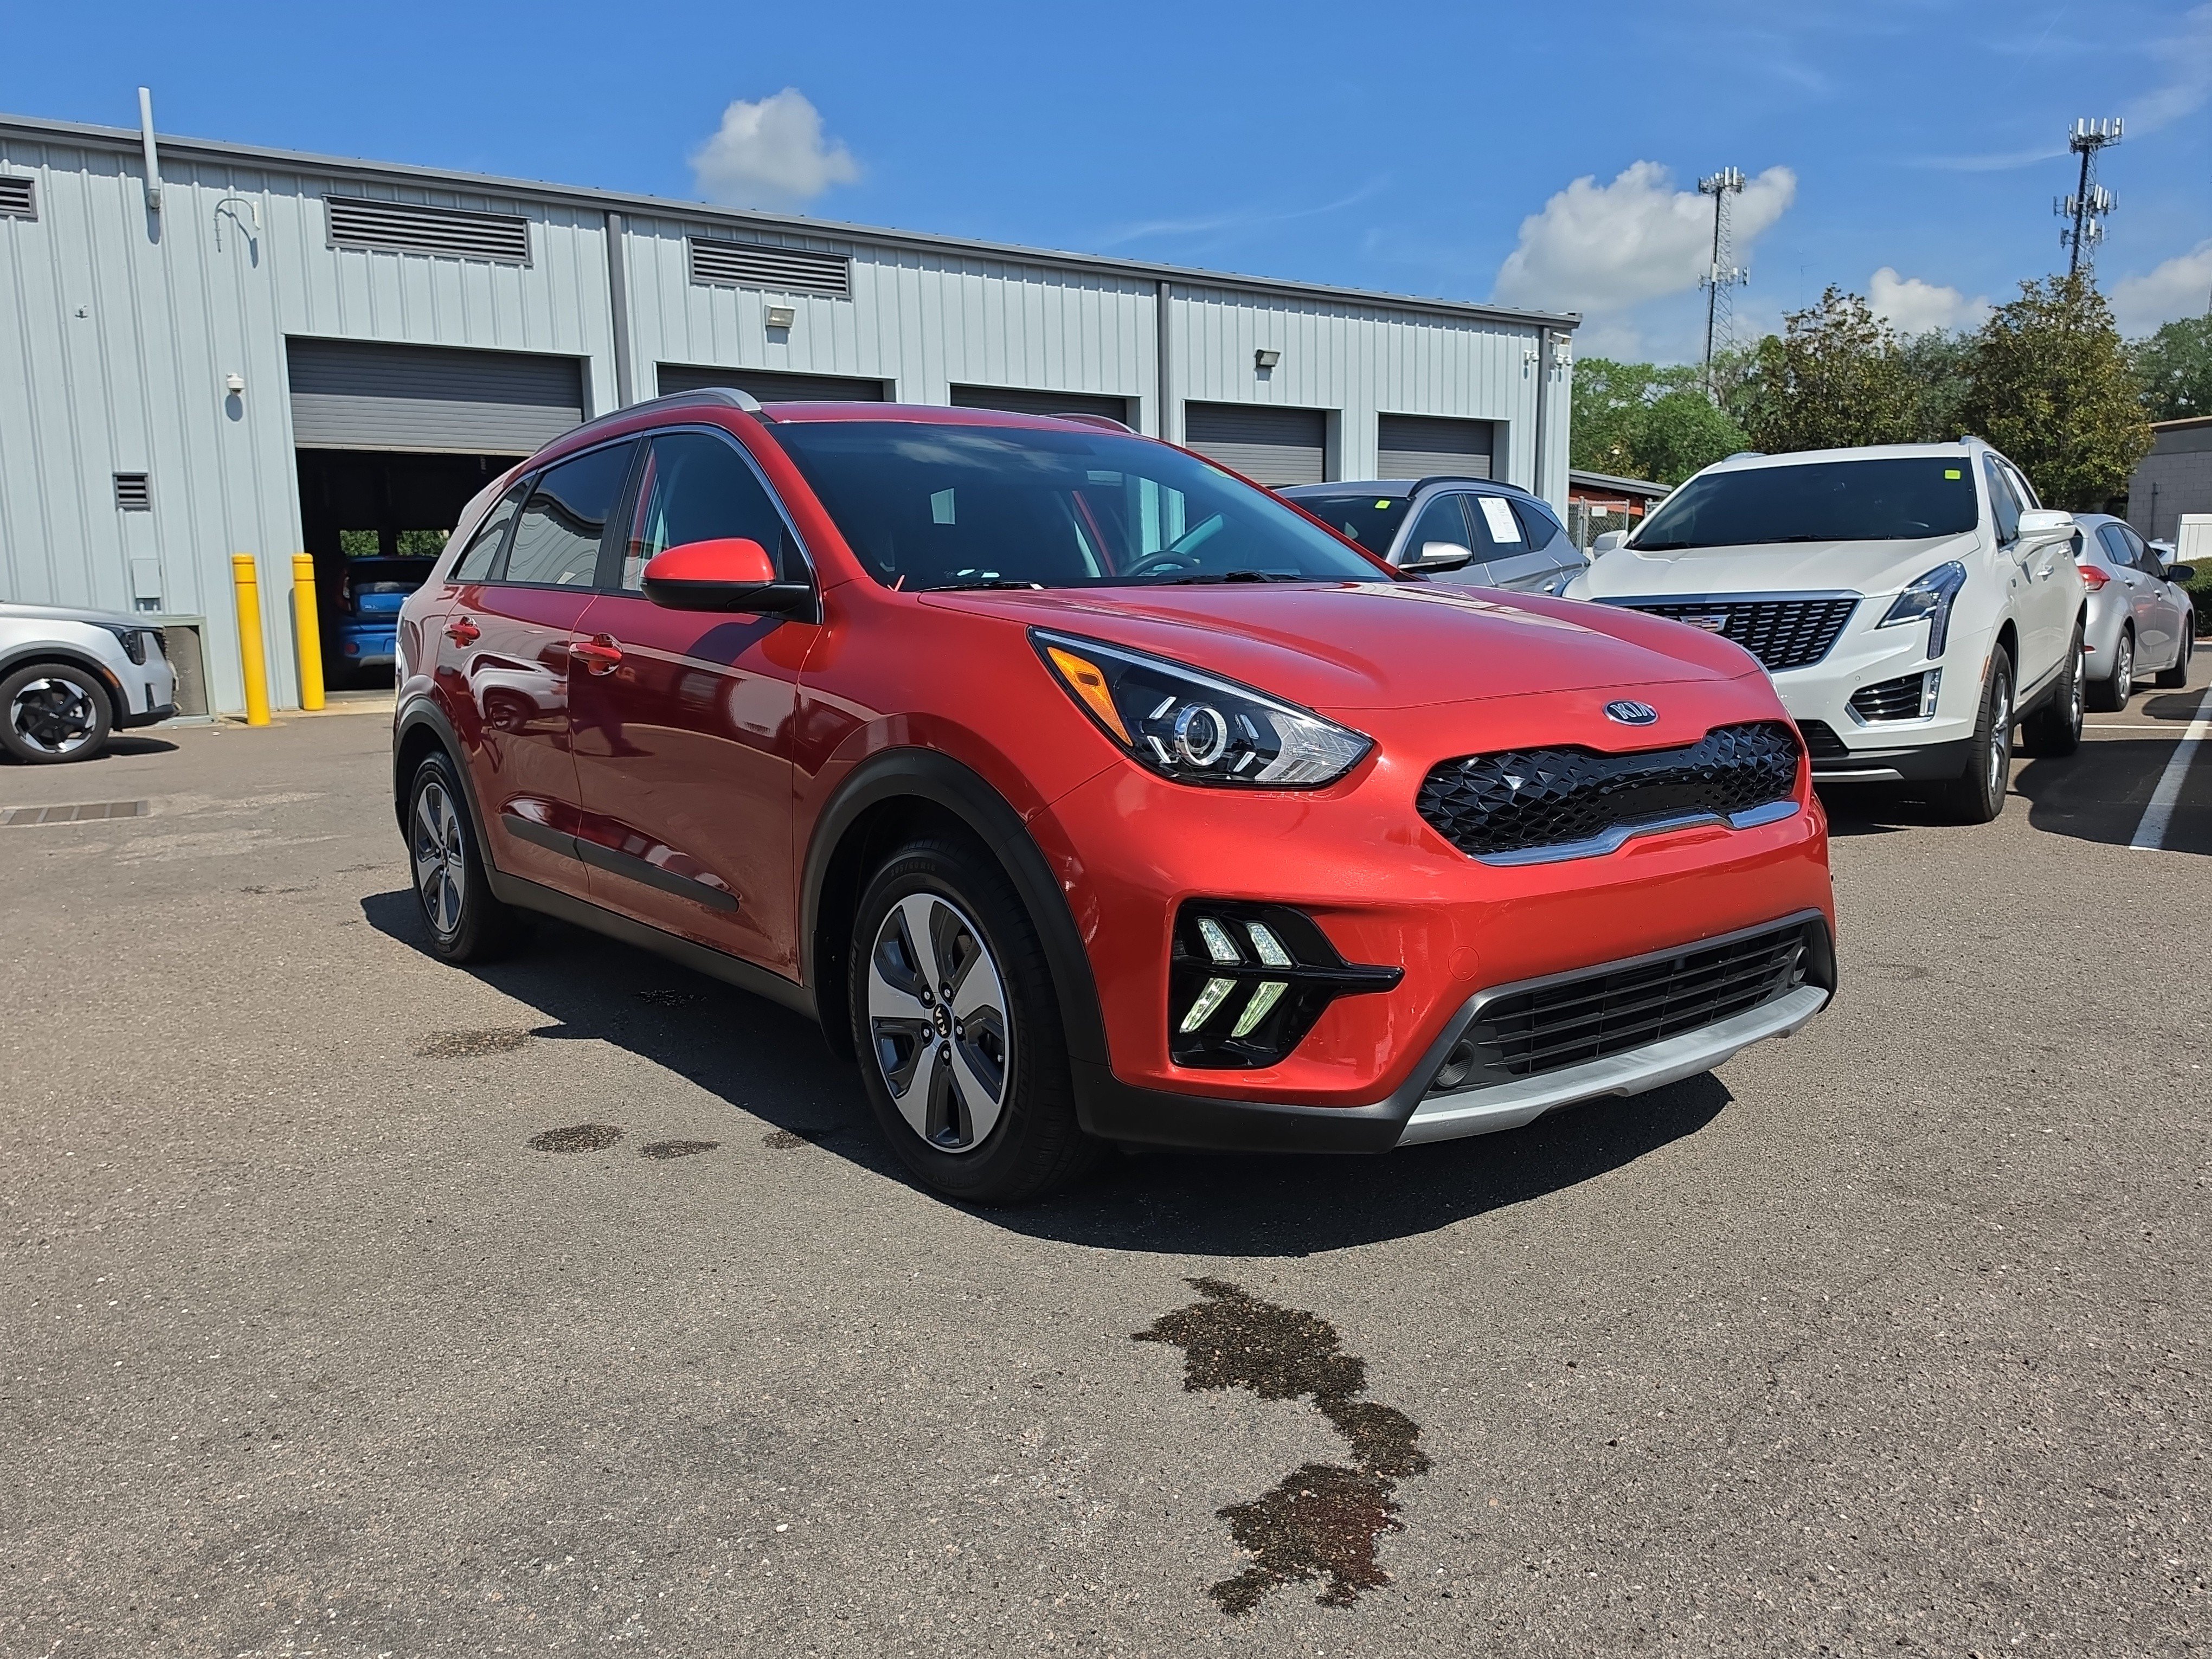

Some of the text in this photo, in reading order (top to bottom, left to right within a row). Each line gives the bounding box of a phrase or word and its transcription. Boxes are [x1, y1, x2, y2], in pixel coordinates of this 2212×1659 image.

[1610, 702, 1655, 720] KIA
[850, 947, 860, 1043] MICHELIN
[935, 1007, 948, 1036] KIA
[1014, 997, 1030, 1110] MICHELIN
